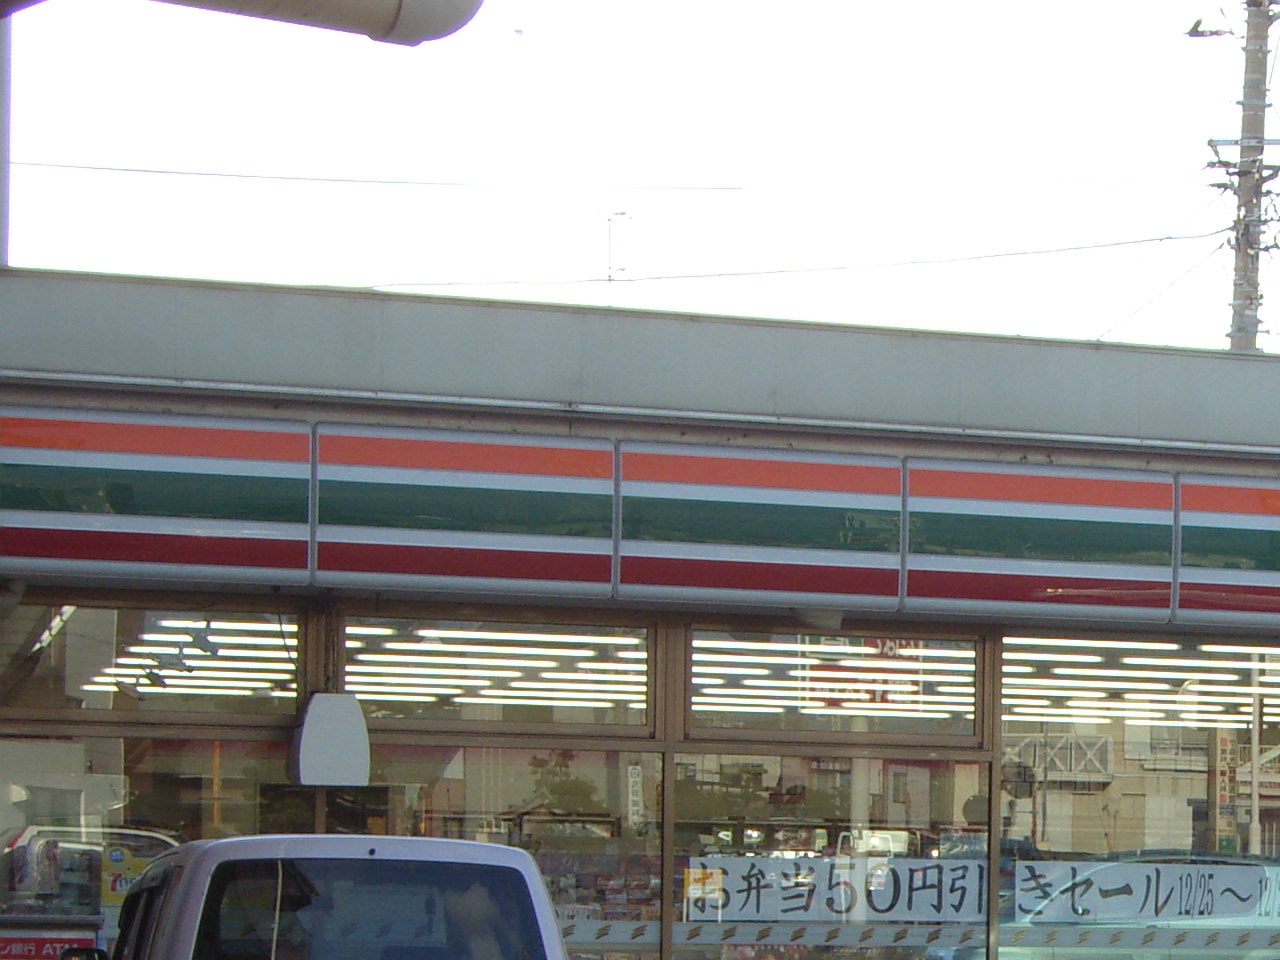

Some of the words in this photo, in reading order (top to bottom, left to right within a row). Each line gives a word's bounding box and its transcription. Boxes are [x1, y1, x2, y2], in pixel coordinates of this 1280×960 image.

[692, 861, 985, 915] お弁当50円引
